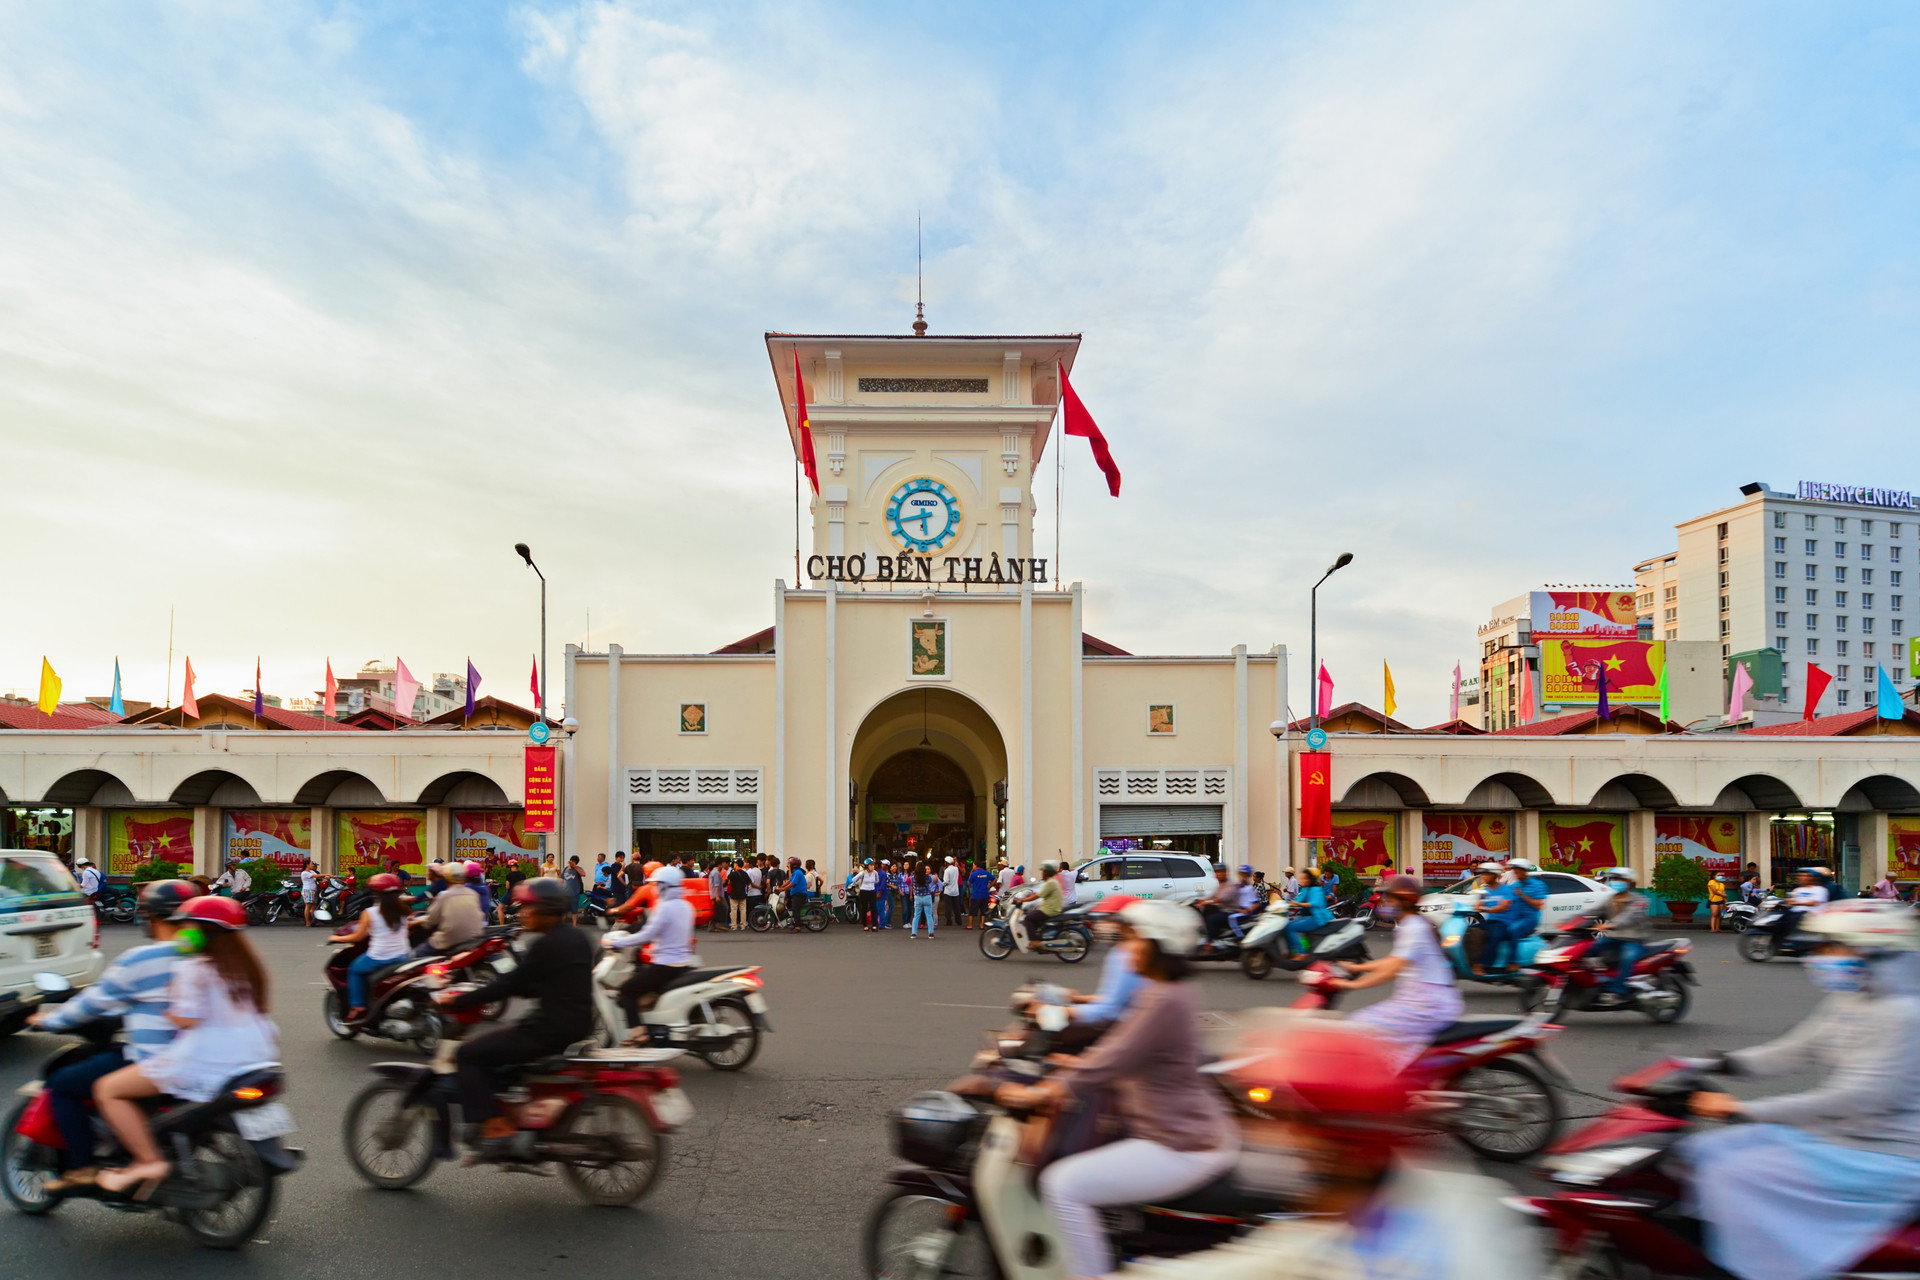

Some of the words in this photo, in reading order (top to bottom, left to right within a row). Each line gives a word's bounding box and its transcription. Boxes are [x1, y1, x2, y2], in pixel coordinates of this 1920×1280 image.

[916, 478, 933, 490] 12
[1799, 480, 1853, 502] LIBERTY
[1855, 486, 1917, 509] CENTRAL
[886, 508, 897, 520] 9
[807, 552, 866, 584] CHỢ
[876, 548, 932, 582] BẾN
[943, 551, 1048, 583] THÀNH
